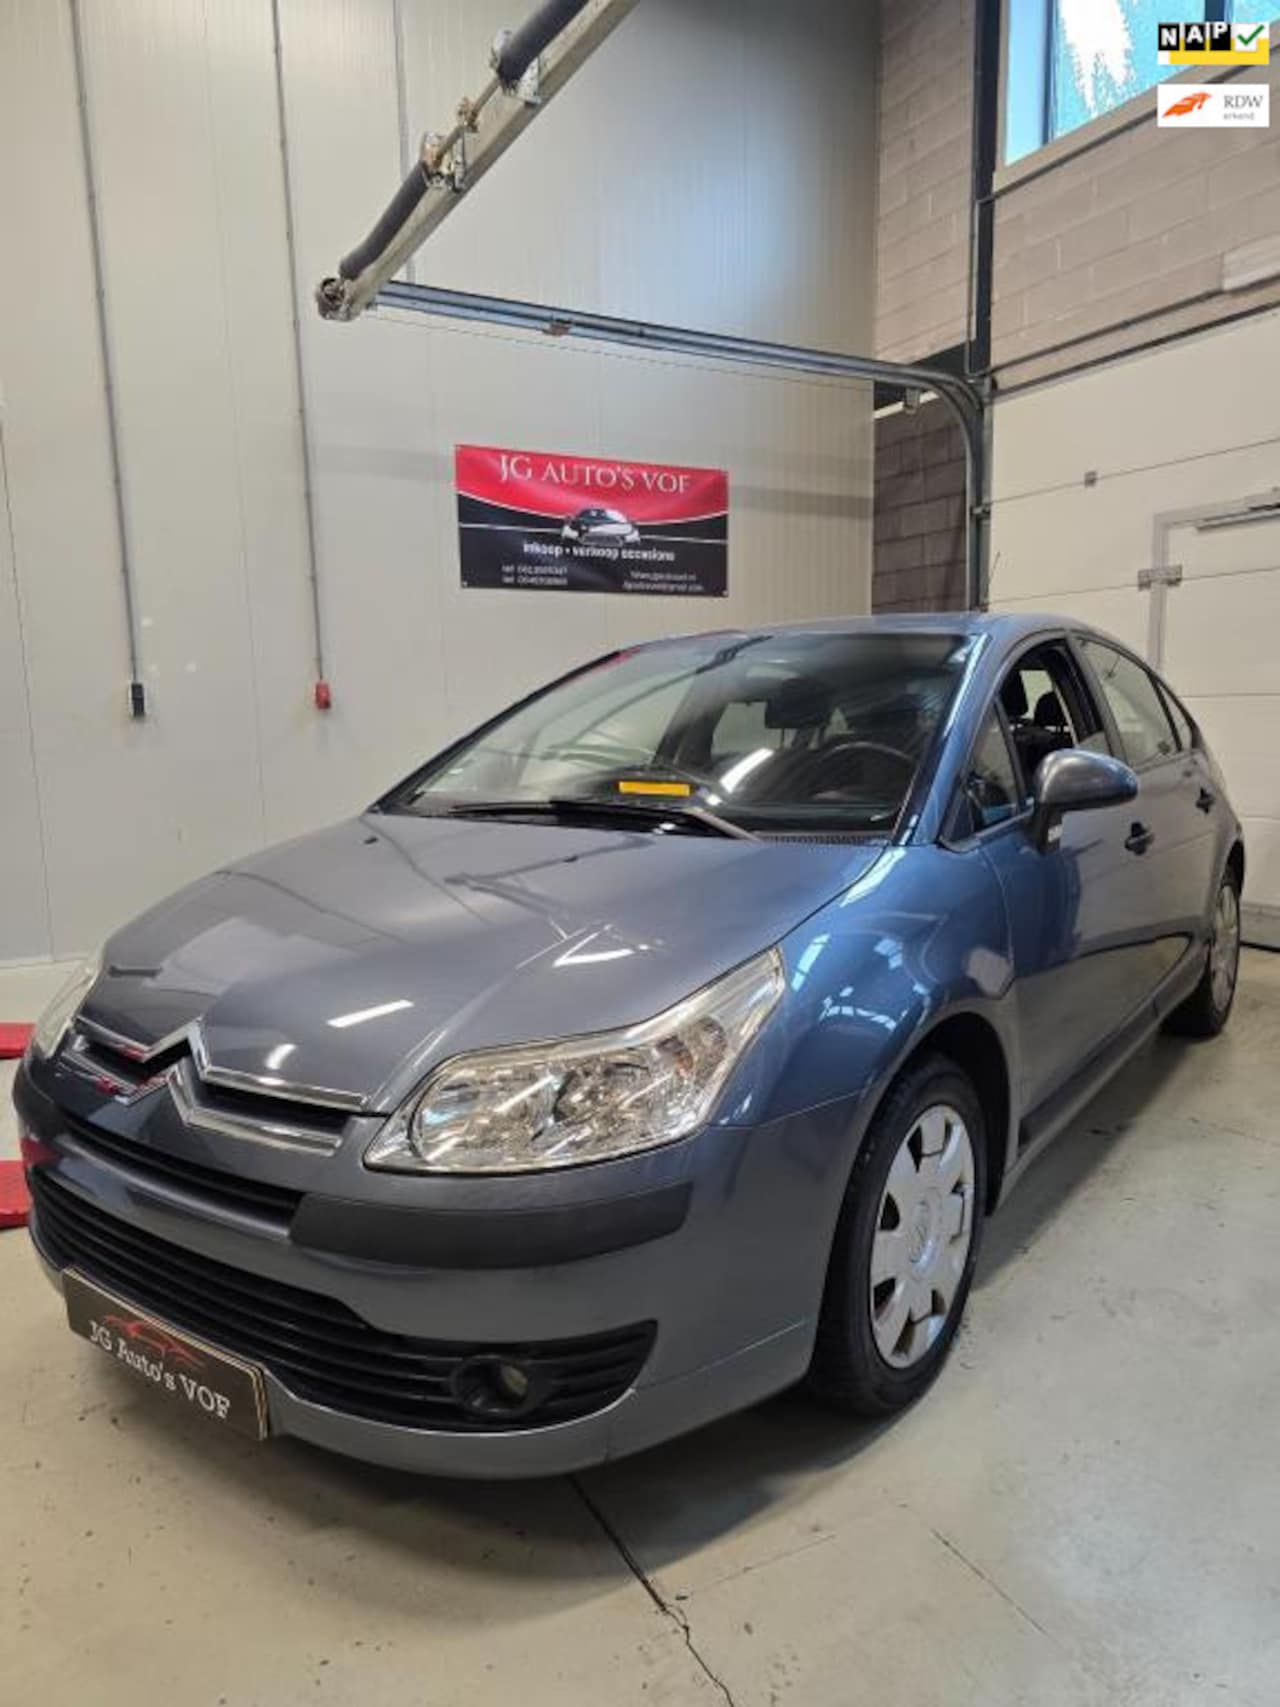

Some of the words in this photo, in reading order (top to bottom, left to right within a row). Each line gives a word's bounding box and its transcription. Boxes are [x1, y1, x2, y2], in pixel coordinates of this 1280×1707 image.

[500, 455, 532, 483] JG
[541, 461, 635, 491] AUTO'S
[641, 471, 691, 493] VOF
[88, 1320, 113, 1350] JG
[115, 1337, 177, 1391] Auto's
[178, 1374, 231, 1419] VOF
